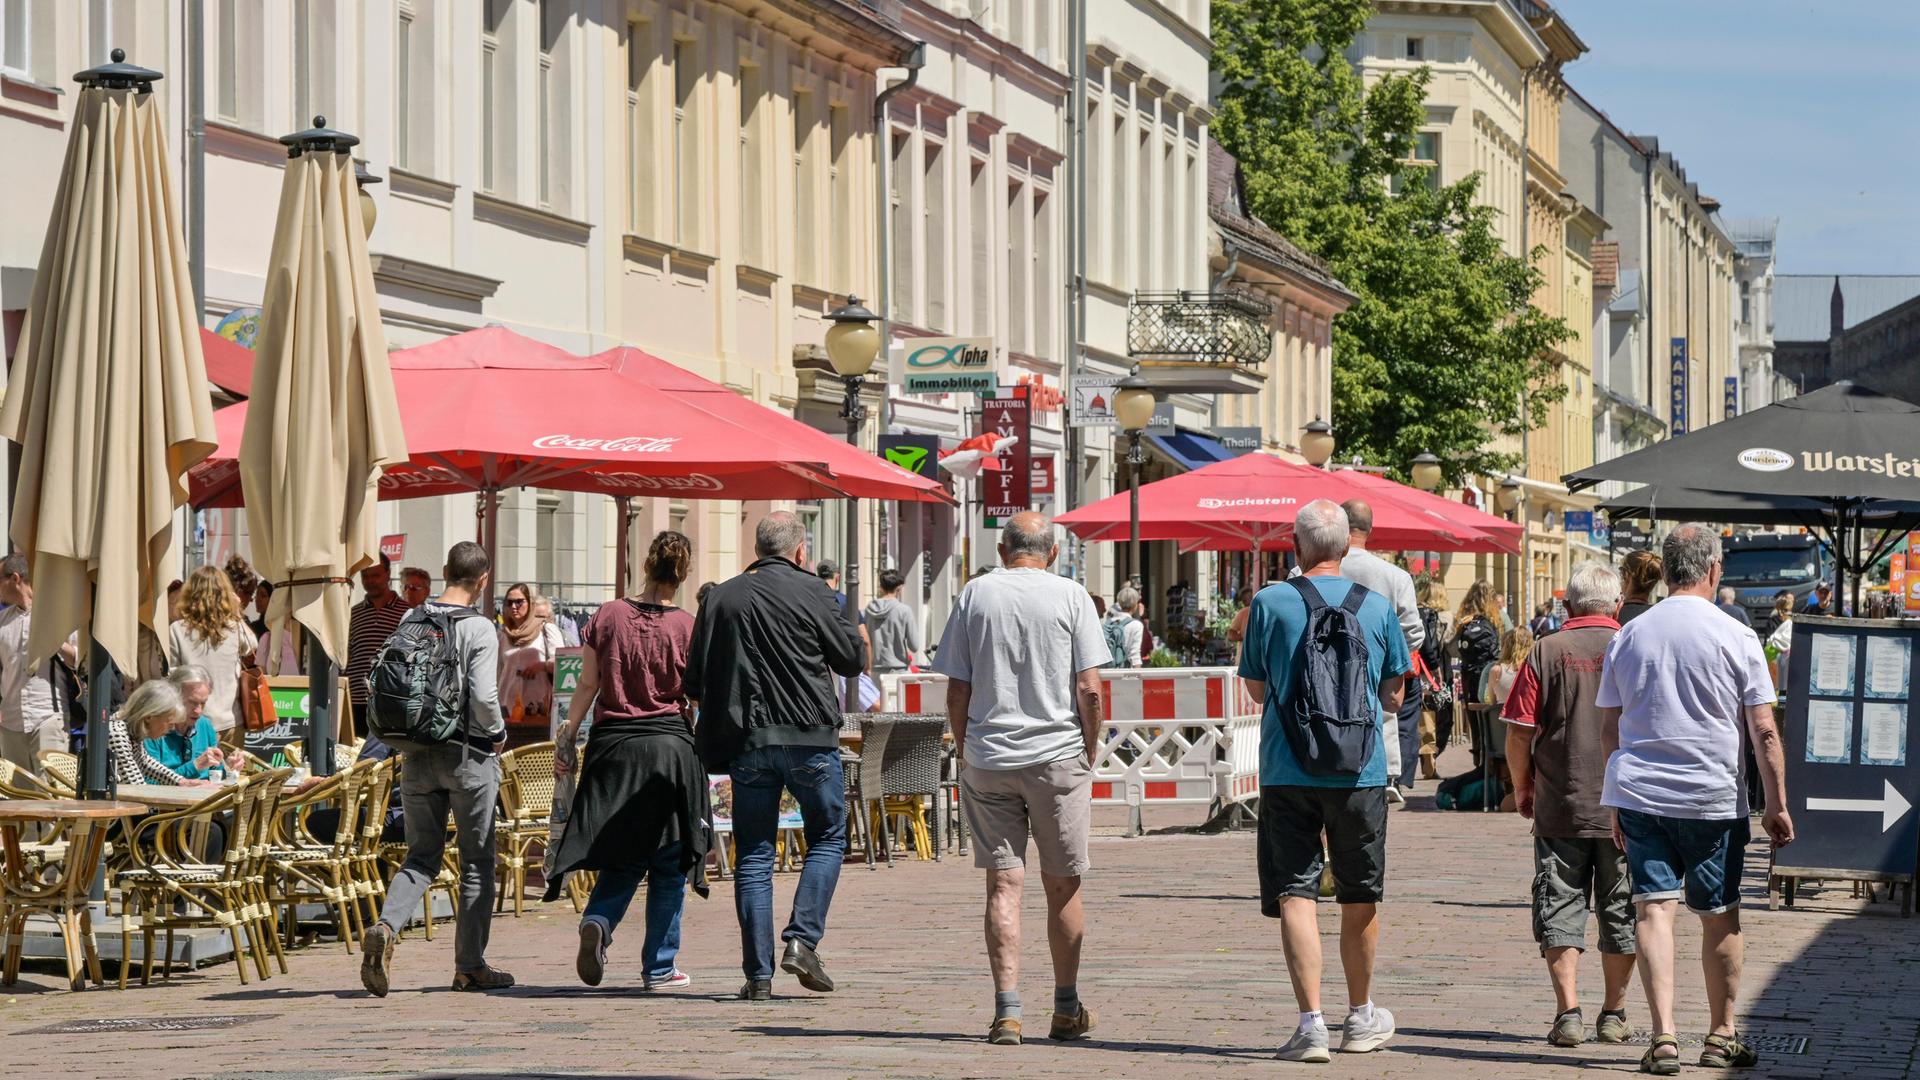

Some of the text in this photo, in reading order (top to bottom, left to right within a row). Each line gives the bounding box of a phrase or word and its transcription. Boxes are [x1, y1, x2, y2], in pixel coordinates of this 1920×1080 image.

[910, 377, 989, 390] Immobilien
[1672, 345, 1685, 437] KARSTA
[984, 400, 1026, 409] TRATTORIA
[1147, 413, 1170, 427] alia
[533, 434, 683, 452] Coca-Cola
[1223, 436, 1258, 448] Thalia
[997, 410, 1015, 504] AMALFI
[987, 505, 1027, 516] PIZZERIA
[381, 543, 402, 556] SALE
[1747, 595, 1776, 604] IVEC
